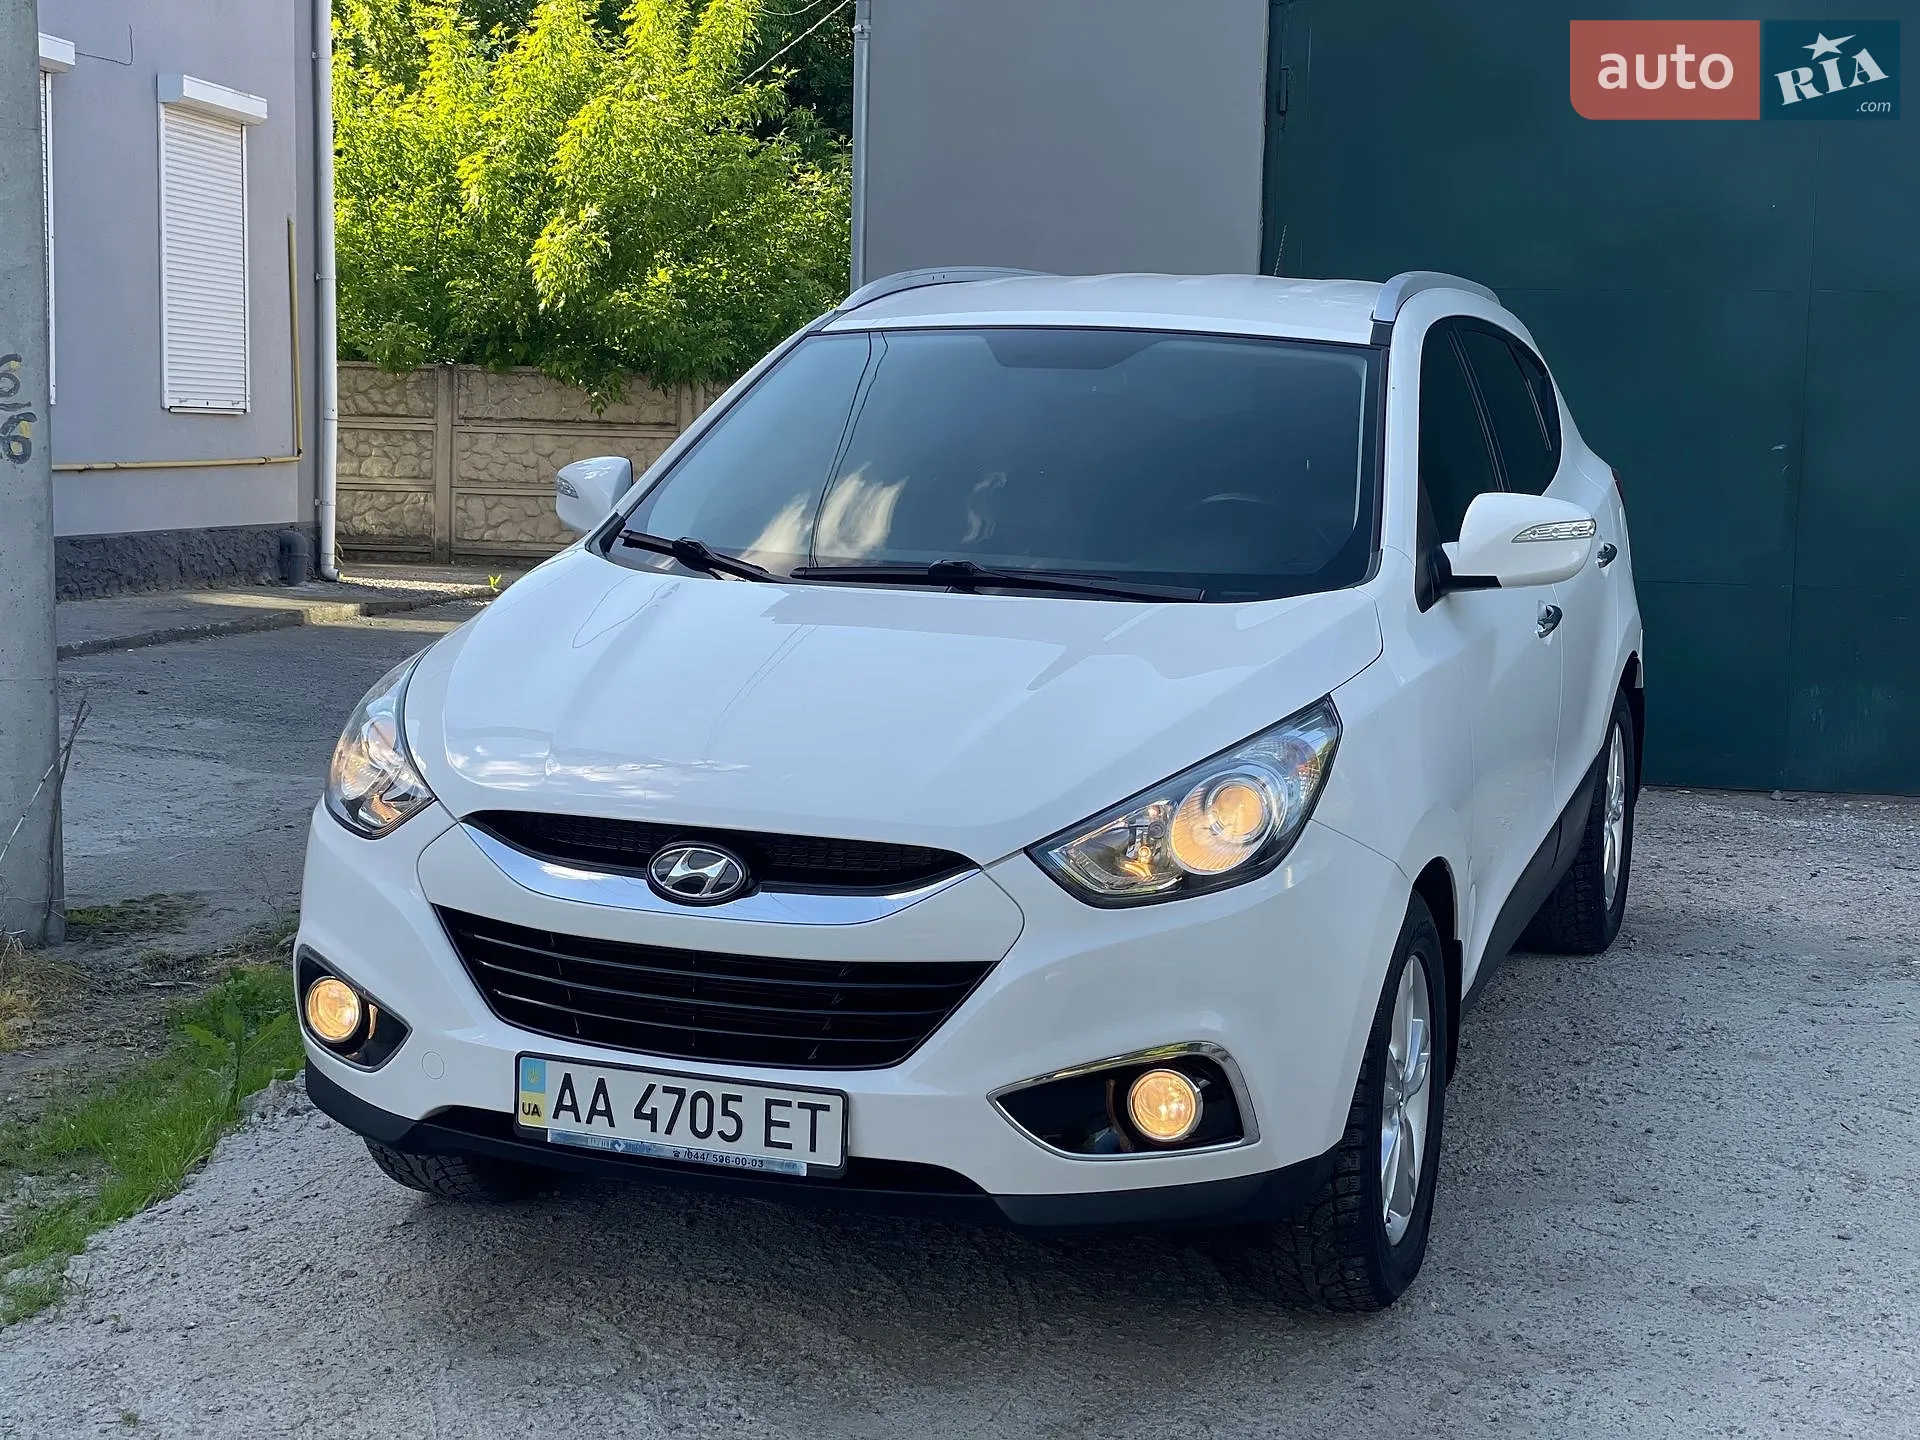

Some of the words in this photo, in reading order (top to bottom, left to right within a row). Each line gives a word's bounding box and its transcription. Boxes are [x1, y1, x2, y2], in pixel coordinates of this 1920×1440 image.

[522, 1102, 542, 1118] UA
[552, 1072, 616, 1128] AA
[633, 1083, 744, 1143] 4705
[763, 1097, 831, 1153] ET
[712, 1154, 764, 1168] 596-00-03
